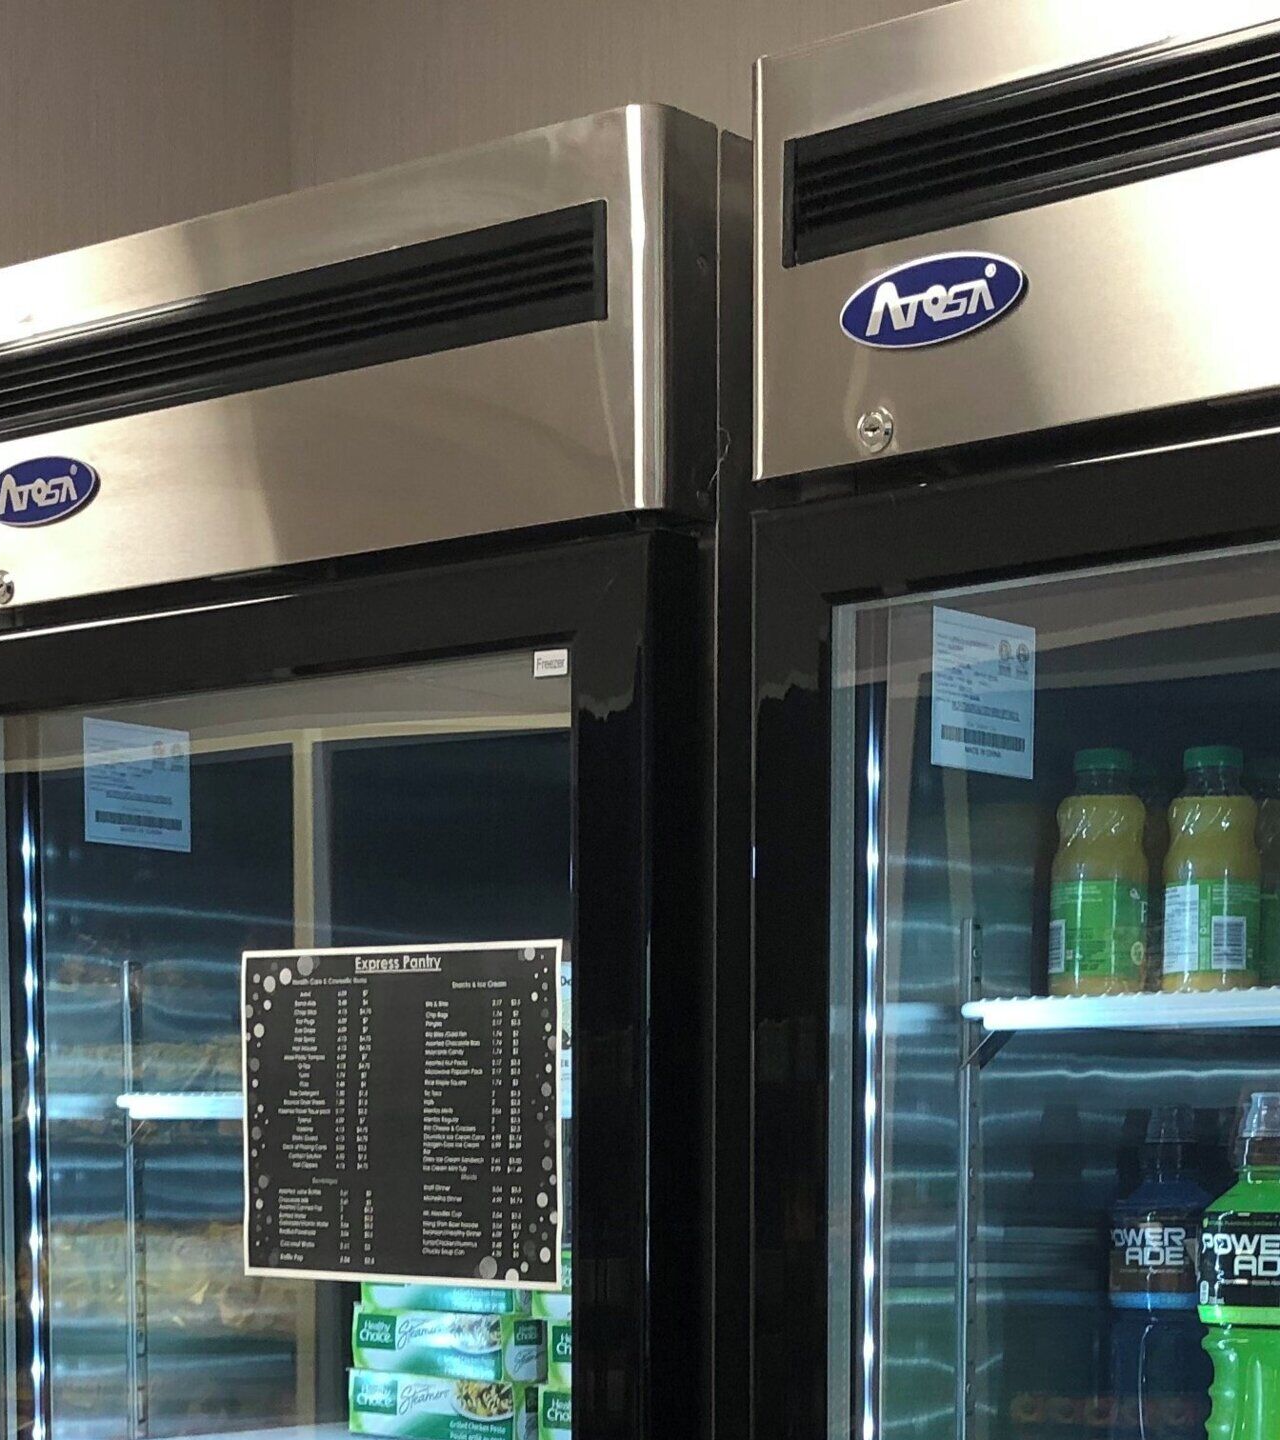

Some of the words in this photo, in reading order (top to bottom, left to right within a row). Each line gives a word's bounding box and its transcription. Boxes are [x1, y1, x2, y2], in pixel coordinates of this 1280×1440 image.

[536, 657, 566, 672] Freezer
[355, 956, 400, 974] Express
[403, 956, 442, 973] Pantry
[1125, 1247, 1185, 1266] ADE
[363, 1320, 390, 1334] Healthy
[359, 1328, 393, 1344] Choice
[399, 1387, 450, 1415] Steamers
[468, 1422, 489, 1434] Chicken
[490, 1425, 506, 1436] Pesto
